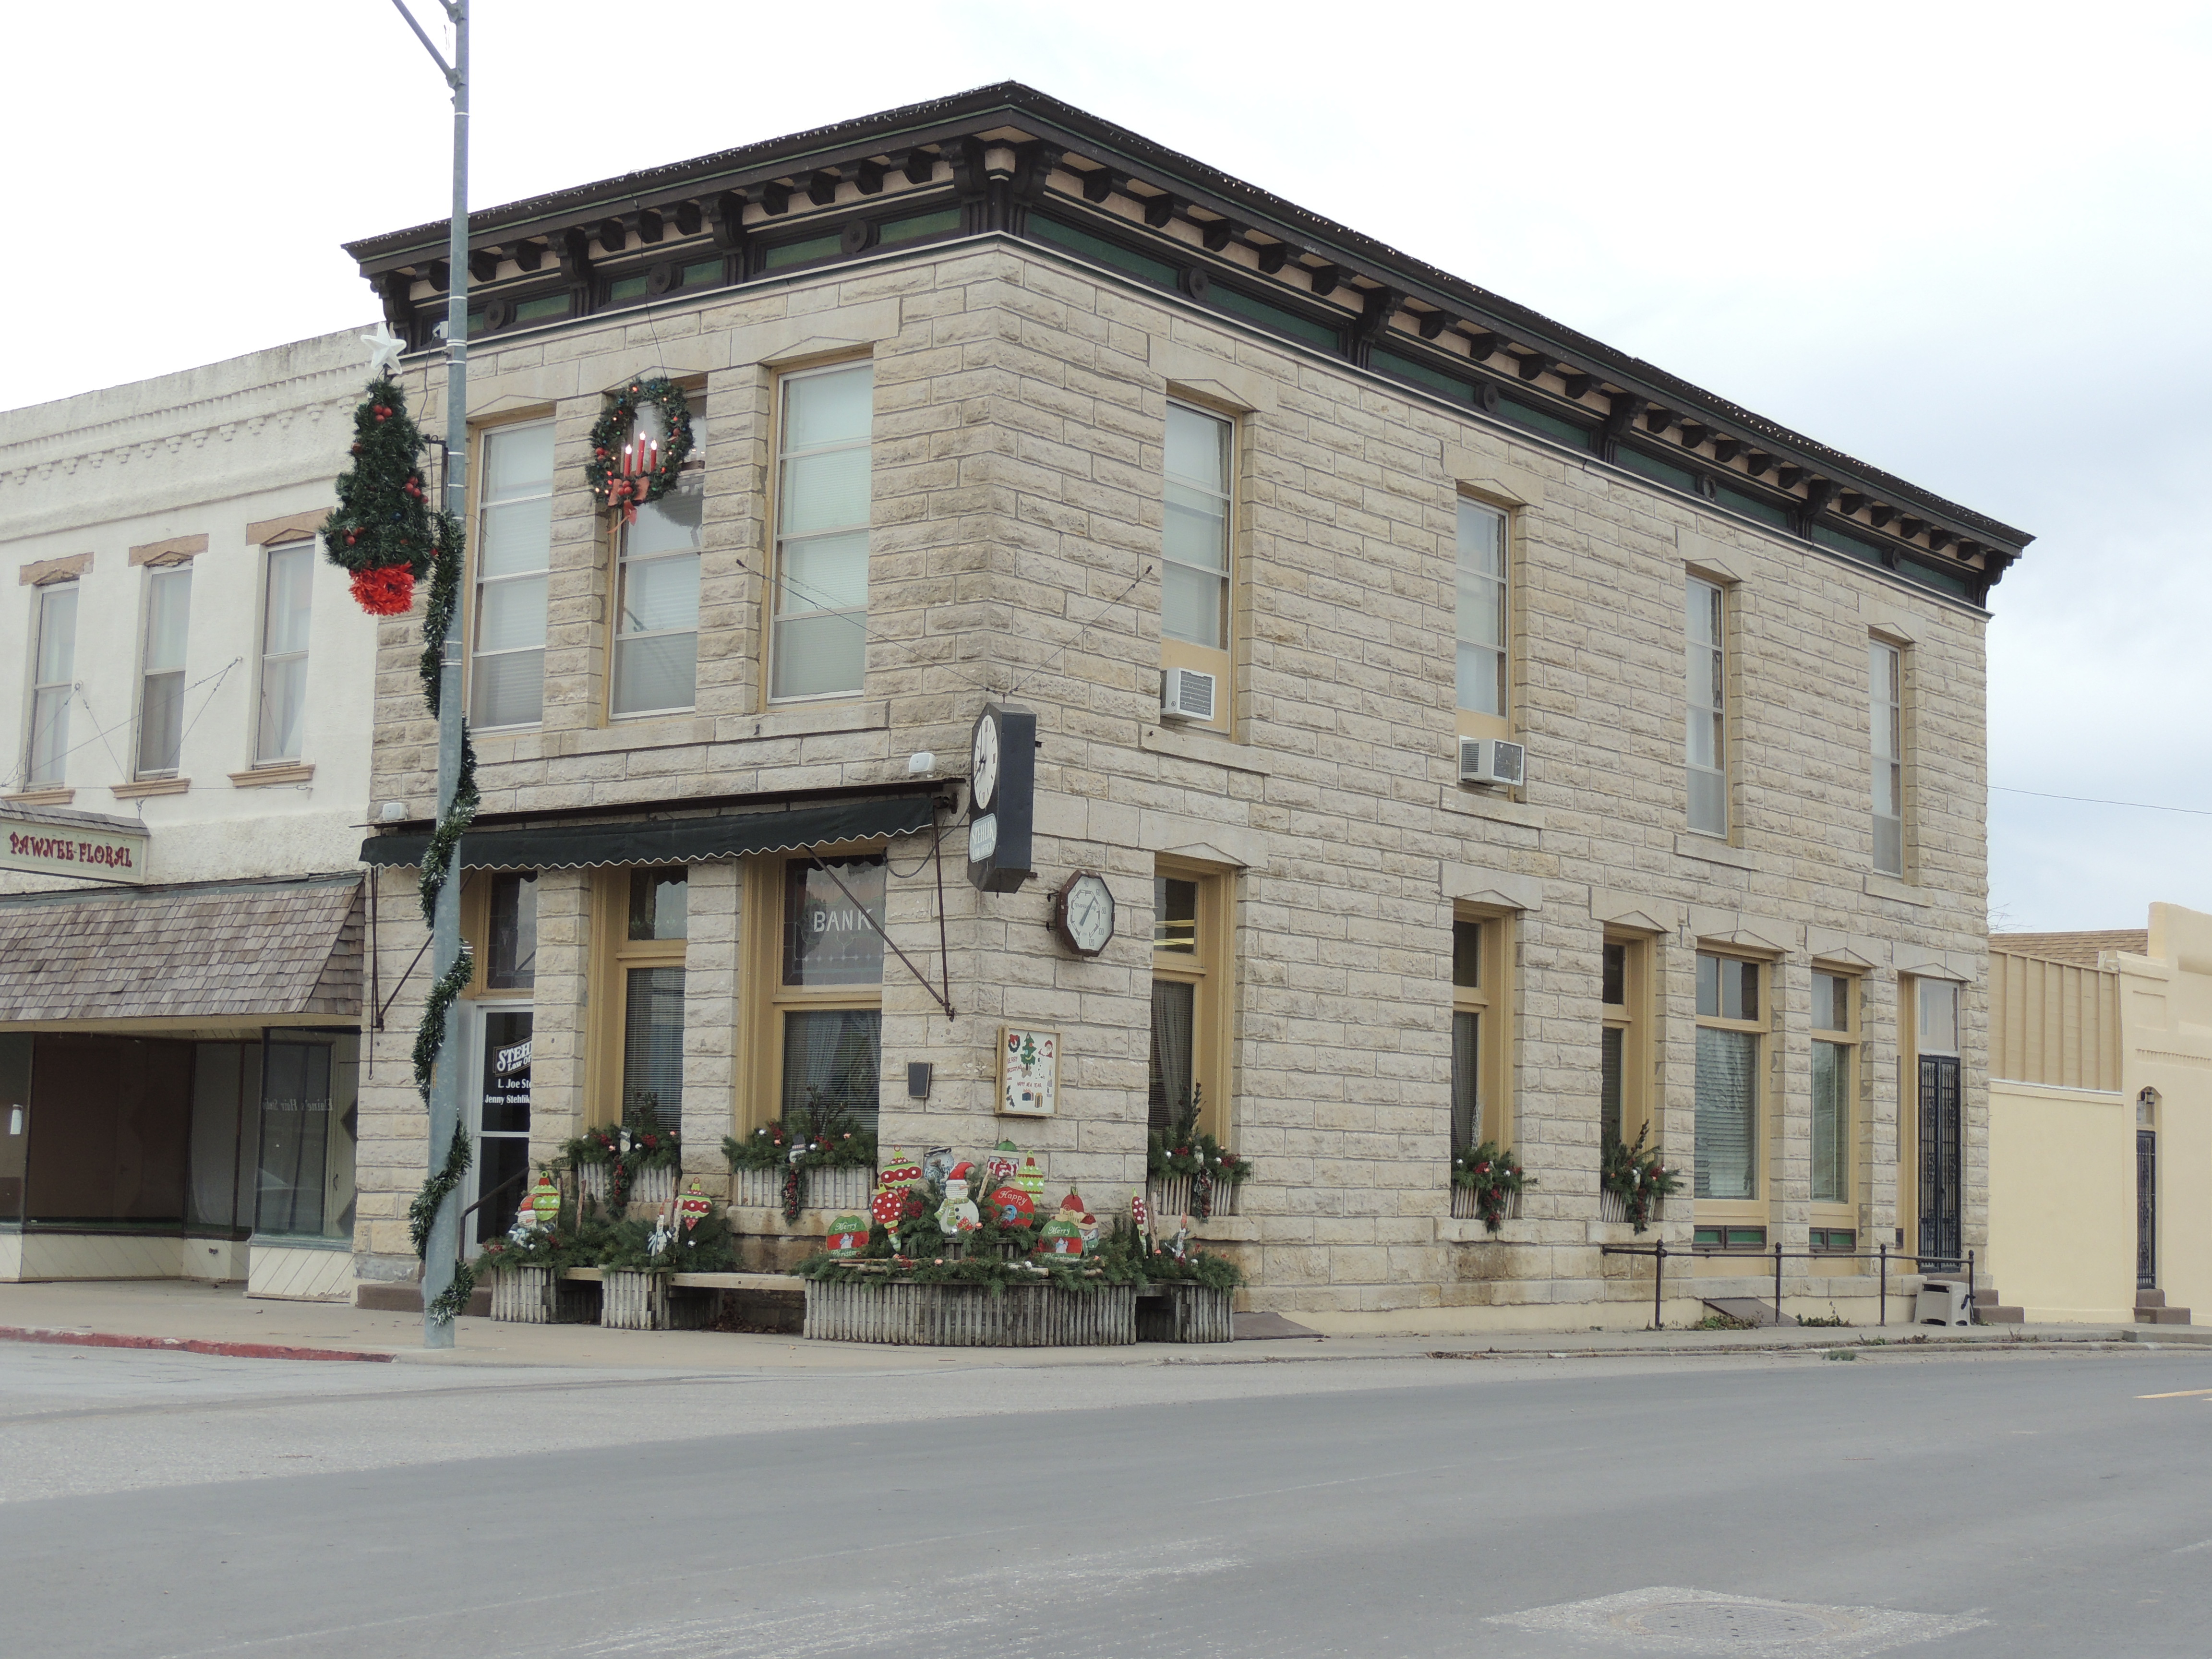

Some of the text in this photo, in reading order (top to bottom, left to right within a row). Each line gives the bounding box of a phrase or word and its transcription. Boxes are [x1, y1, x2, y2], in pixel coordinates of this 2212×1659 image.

[971, 818, 996, 846] STEHLIK
[10, 831, 132, 868] PAWNEE FLORAL
[813, 908, 873, 932] BANK
[507, 1060, 522, 1071] Law
[506, 1079, 520, 1088] Joe
[485, 1094, 530, 1105] Jenny Stehlik
[998, 1190, 1028, 1206] Happy
[835, 1222, 857, 1231] Merry
[1048, 1226, 1070, 1236] Merry
